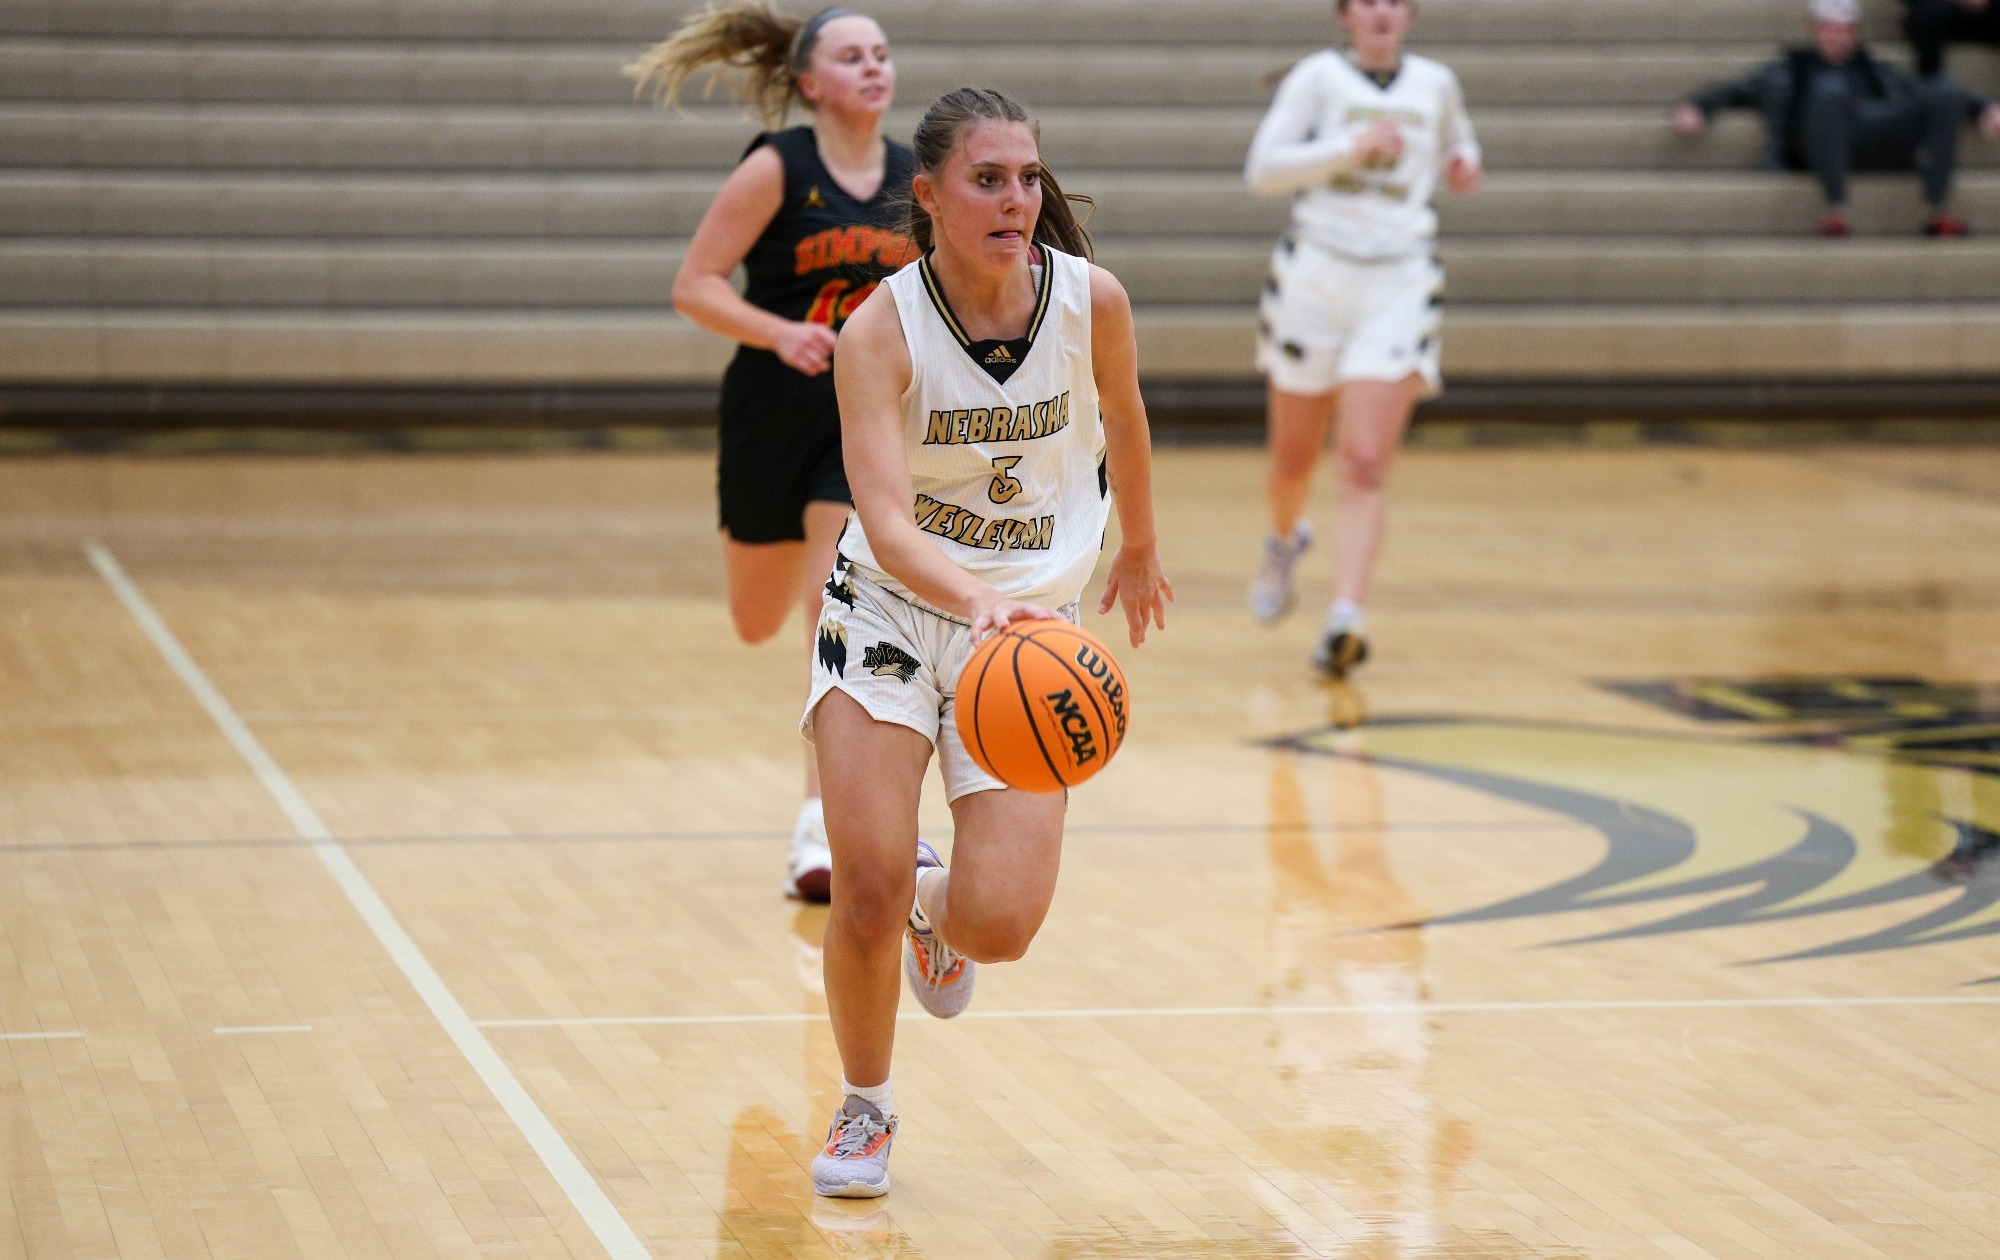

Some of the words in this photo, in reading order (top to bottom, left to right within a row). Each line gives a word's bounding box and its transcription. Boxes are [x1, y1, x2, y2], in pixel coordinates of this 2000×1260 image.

[795, 225, 921, 276] SIMP
[984, 356, 1017, 364] adidas
[988, 456, 1023, 505] 5
[914, 494, 1055, 551] WESLEYAN
[1046, 688, 1097, 767] NCAA
